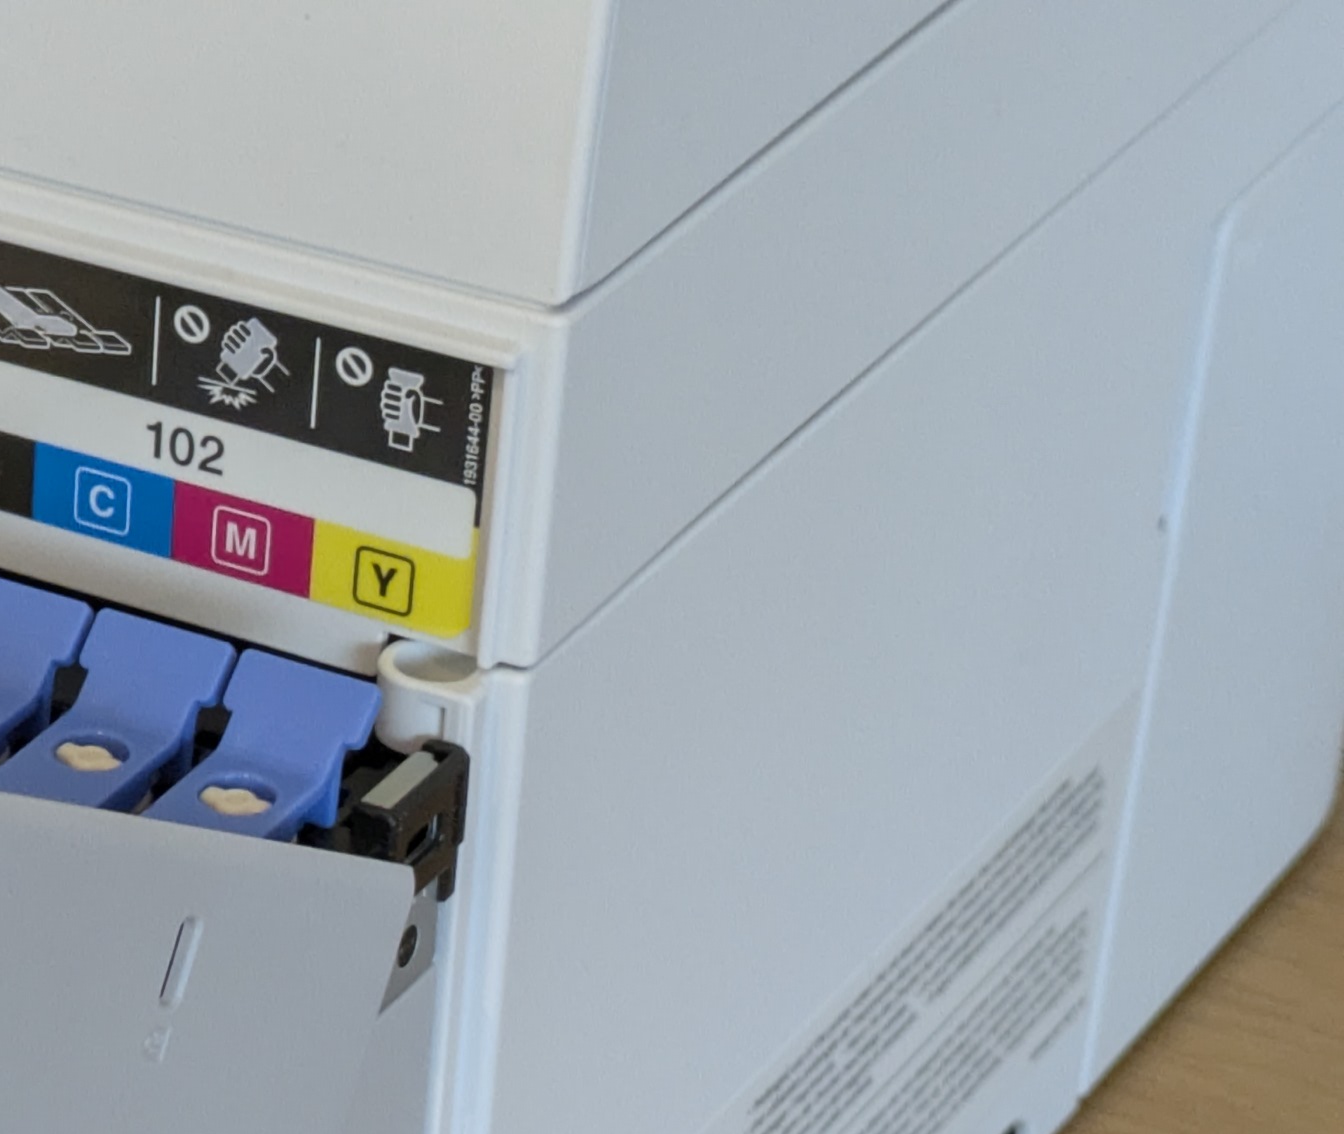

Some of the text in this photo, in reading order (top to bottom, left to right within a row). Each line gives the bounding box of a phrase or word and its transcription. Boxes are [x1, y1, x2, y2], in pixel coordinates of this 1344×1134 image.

[144, 419, 226, 475] 102
[87, 485, 116, 519] C
[224, 521, 258, 560] M
[370, 561, 399, 598] Y
